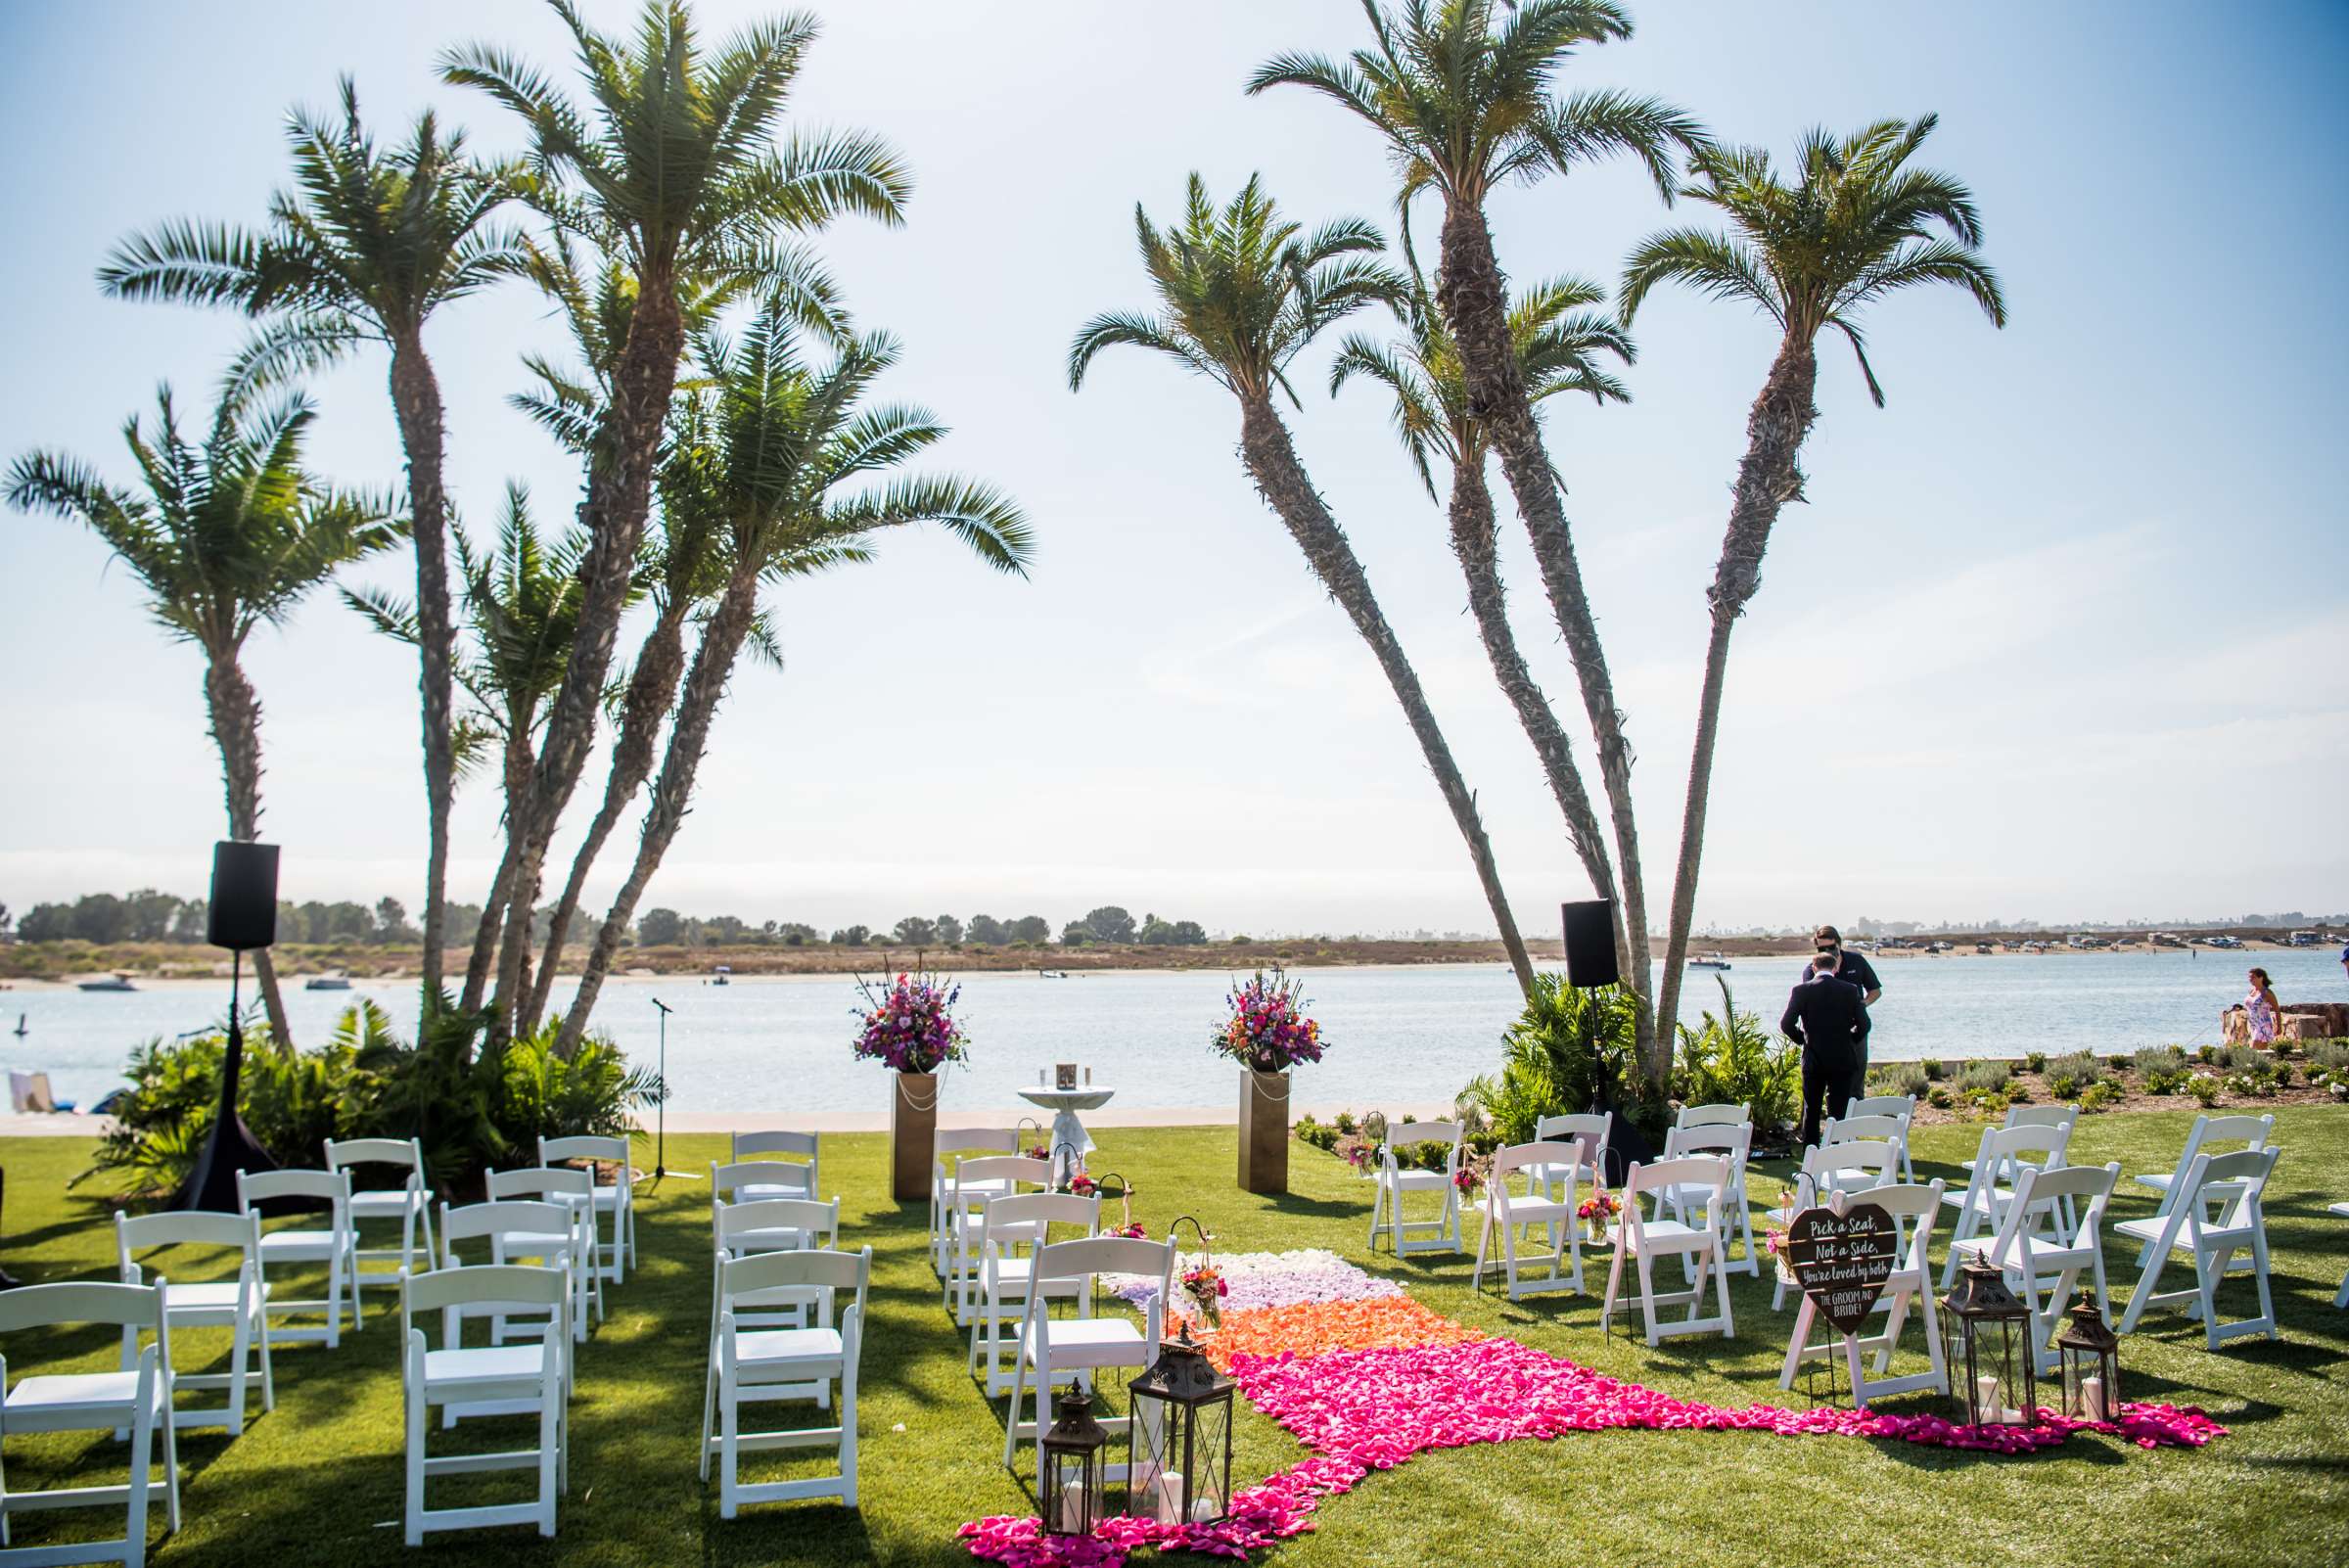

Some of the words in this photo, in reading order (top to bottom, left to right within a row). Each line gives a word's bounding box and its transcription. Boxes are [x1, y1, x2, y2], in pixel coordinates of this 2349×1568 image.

[1810, 1220, 1837, 1236] Pick
[1837, 1223, 1848, 1233] a
[1849, 1215, 1878, 1233] Seat,
[1816, 1243, 1837, 1261] Not
[1839, 1247, 1849, 1256] a
[1850, 1239, 1878, 1257] Side,
[1803, 1270, 1831, 1285] You're
[1832, 1266, 1856, 1279] loved
[1857, 1264, 1868, 1282] by
[1869, 1261, 1889, 1275] both
[1820, 1295, 1831, 1306] THE
[1832, 1292, 1861, 1306] GROOM
[1862, 1290, 1873, 1302] AND
[1833, 1304, 1862, 1317] BRIDE!
